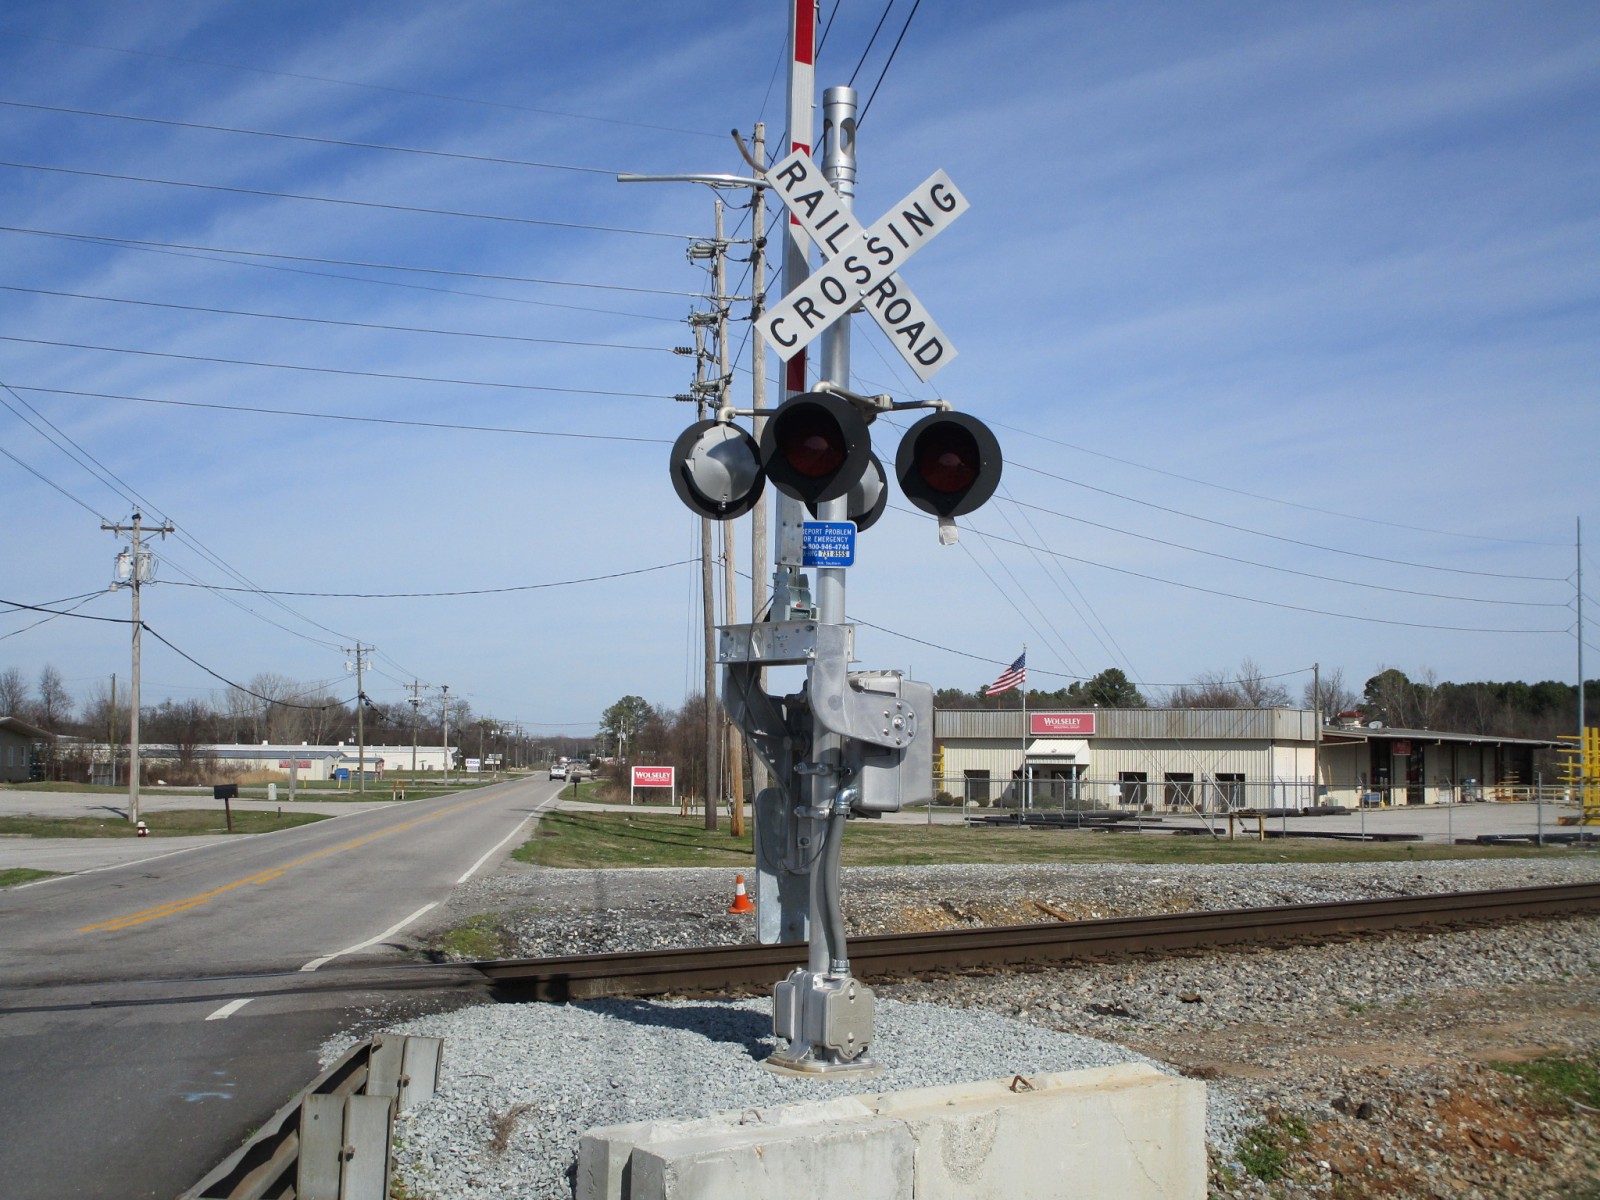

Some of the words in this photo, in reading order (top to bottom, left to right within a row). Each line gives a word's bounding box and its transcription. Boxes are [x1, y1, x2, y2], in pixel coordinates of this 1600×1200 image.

[770, 183, 956, 347] CROSSING
[1043, 717, 1081, 726] WOLSELEY
[635, 771, 671, 779] WOLSELEY
